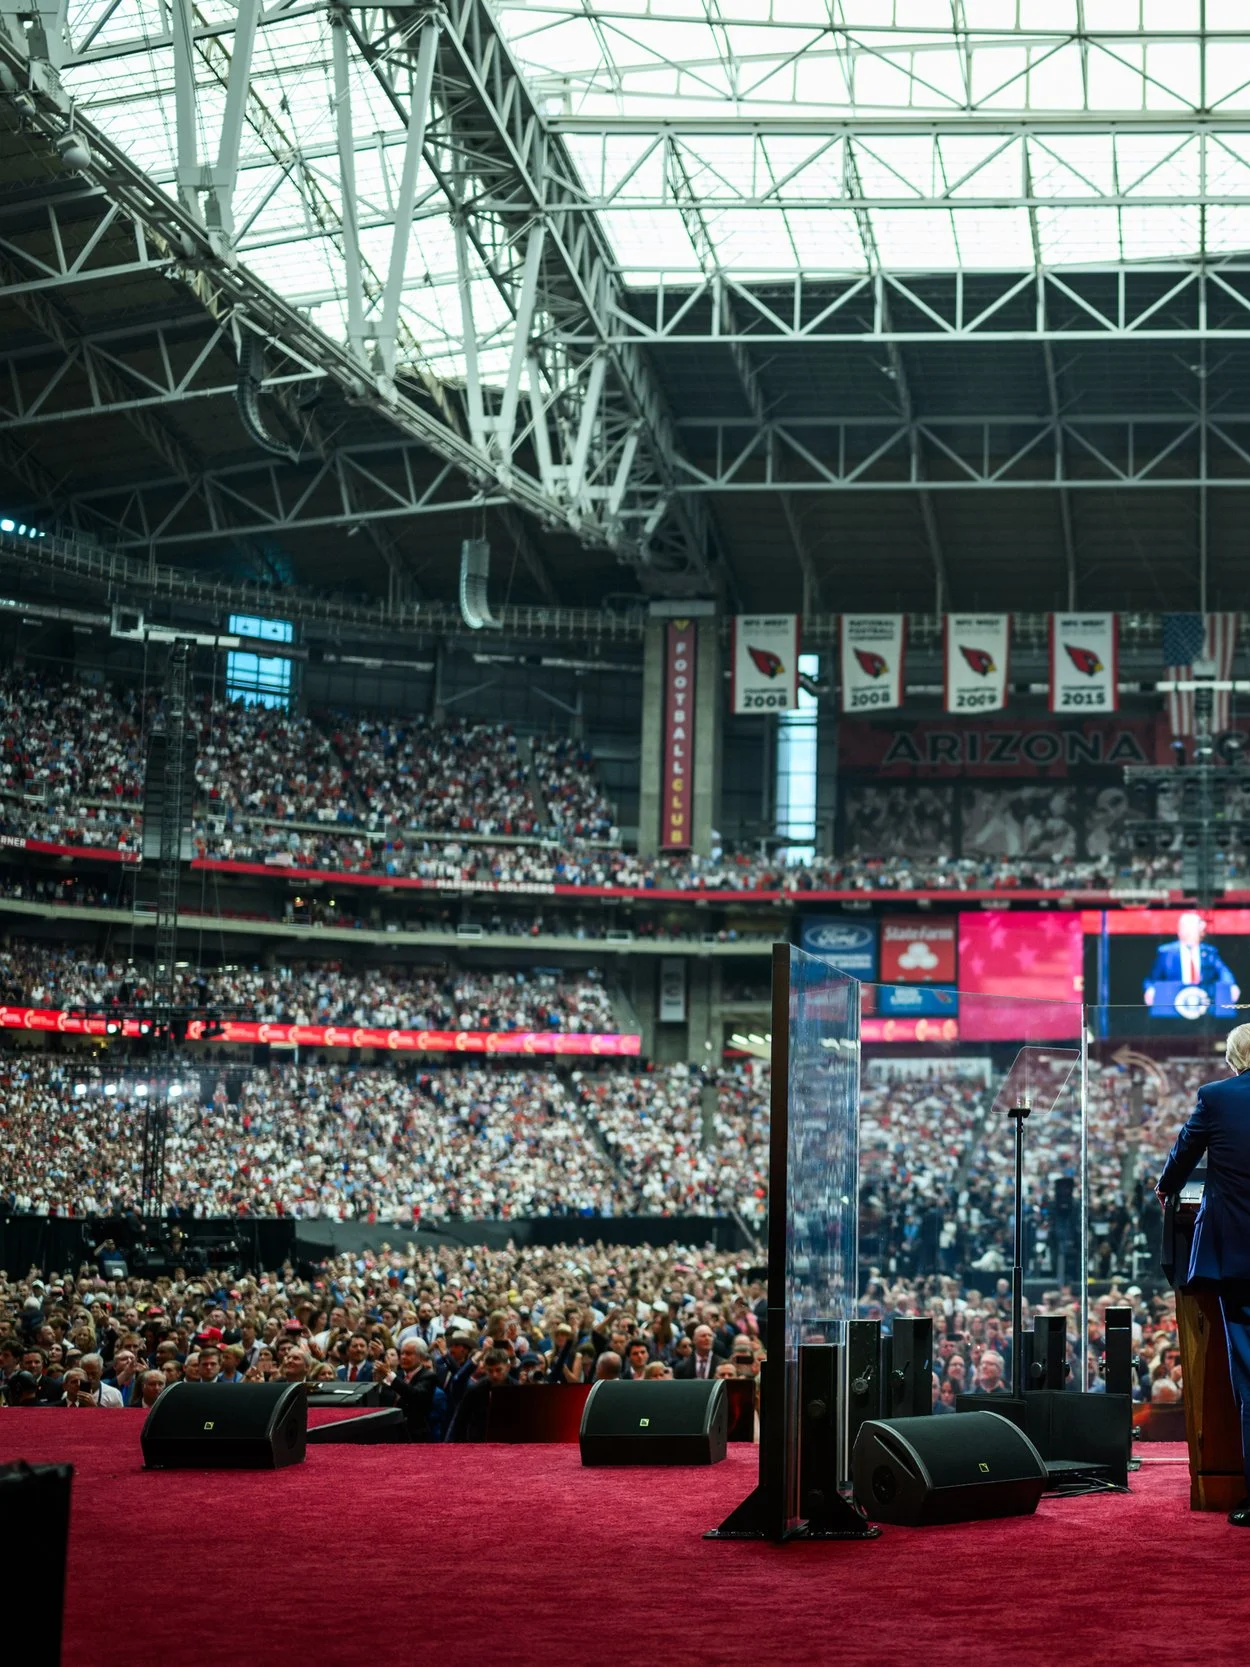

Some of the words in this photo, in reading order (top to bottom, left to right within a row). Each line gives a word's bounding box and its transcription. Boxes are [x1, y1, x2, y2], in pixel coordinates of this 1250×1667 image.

[743, 695, 787, 708] 2008
[852, 693, 891, 706] 2008
[956, 693, 997, 707] 2009
[1061, 692, 1105, 705] 2015
[673, 641, 687, 775] FOOTBALL
[881, 730, 1149, 766] ARIZONA
[670, 778, 684, 843] CLUB
[0, 835, 26, 847] RNER
[817, 927, 860, 946] Ford
